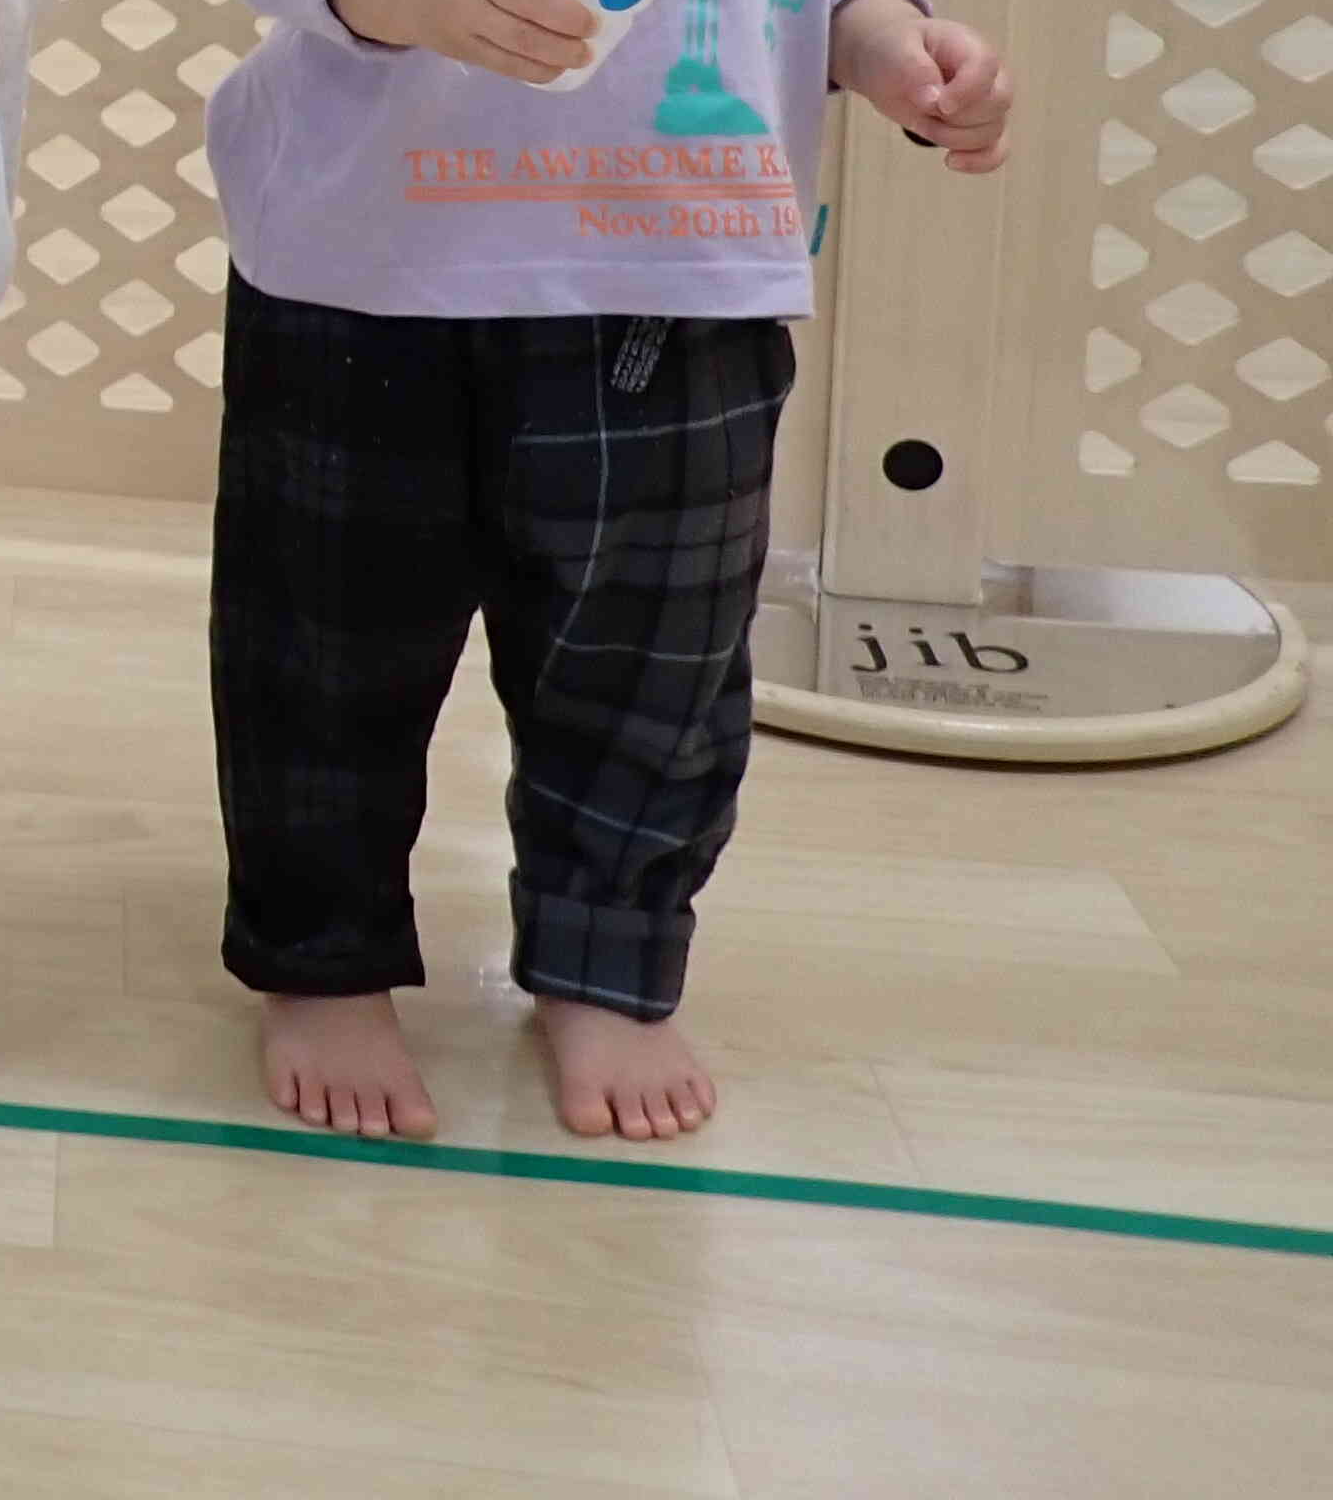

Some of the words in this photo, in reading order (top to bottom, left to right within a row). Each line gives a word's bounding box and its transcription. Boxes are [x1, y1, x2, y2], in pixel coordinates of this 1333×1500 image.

[405, 148, 499, 182] THE
[511, 144, 746, 182] AWESOME
[850, 623, 1029, 674] jib
